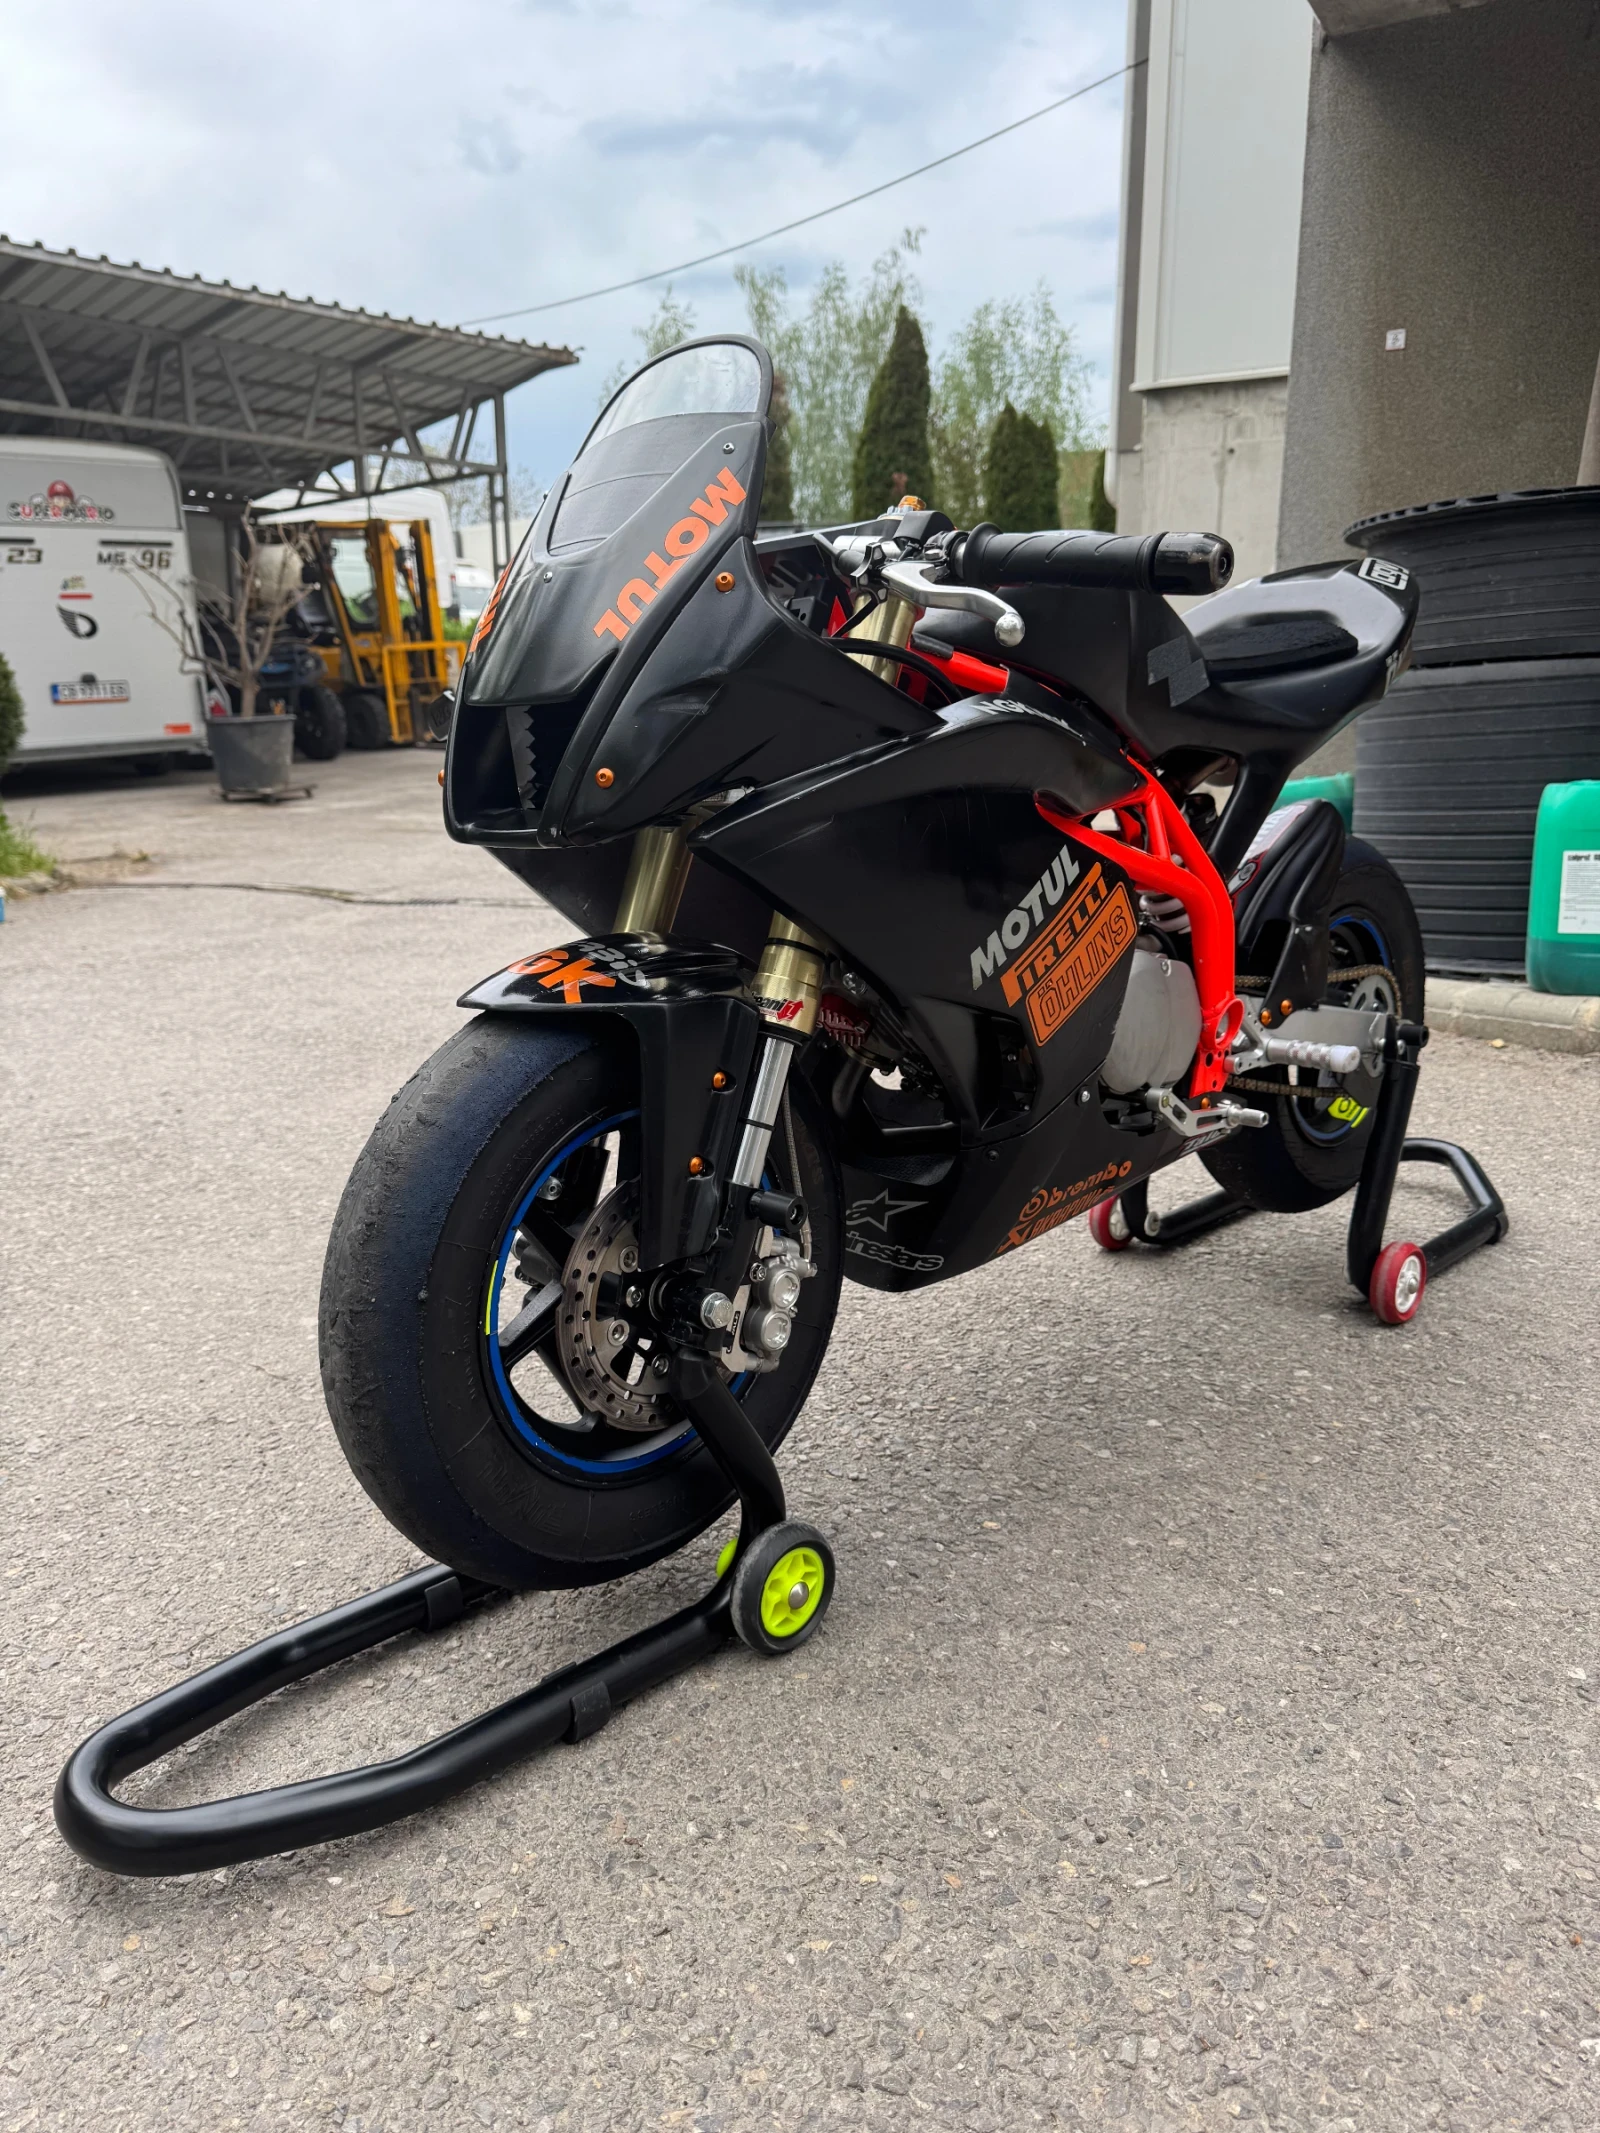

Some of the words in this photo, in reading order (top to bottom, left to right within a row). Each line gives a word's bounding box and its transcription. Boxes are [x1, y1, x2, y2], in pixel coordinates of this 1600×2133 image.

[7, 548, 43, 564] 23
[593, 466, 747, 642] MOTUL
[970, 844, 1080, 990] MOTUL
[1000, 862, 1108, 1008] PIRELLI
[1037, 905, 1129, 1027] ÖHLINS
[1047, 1160, 1132, 1208] brembo
